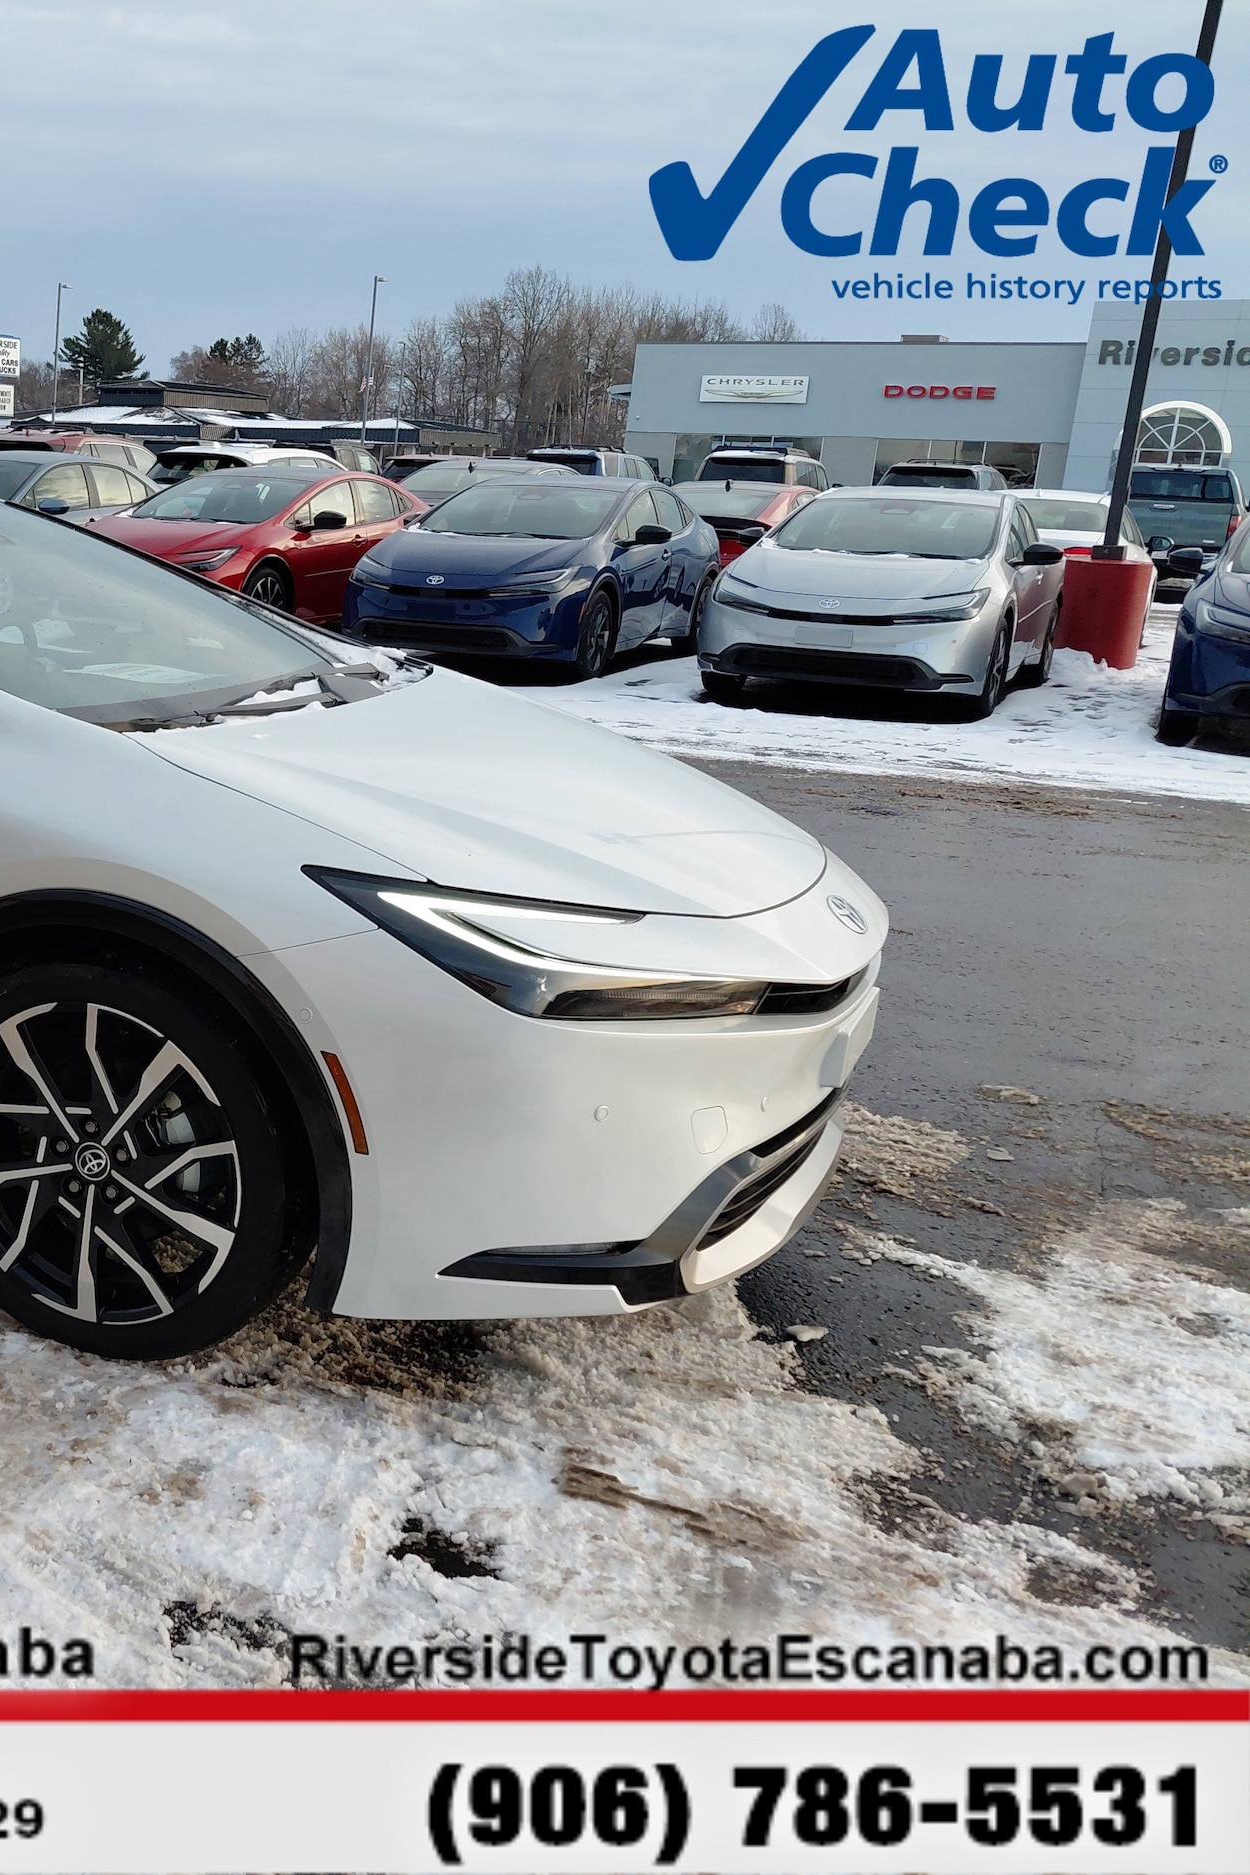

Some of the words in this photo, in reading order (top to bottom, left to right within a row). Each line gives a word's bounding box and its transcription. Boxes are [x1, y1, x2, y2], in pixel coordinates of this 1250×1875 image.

[1098, 340, 1250, 366] Riersi
[1, 358, 19, 367] CARS
[706, 377, 805, 386] CHRYSLER
[883, 384, 997, 400] DODGE
